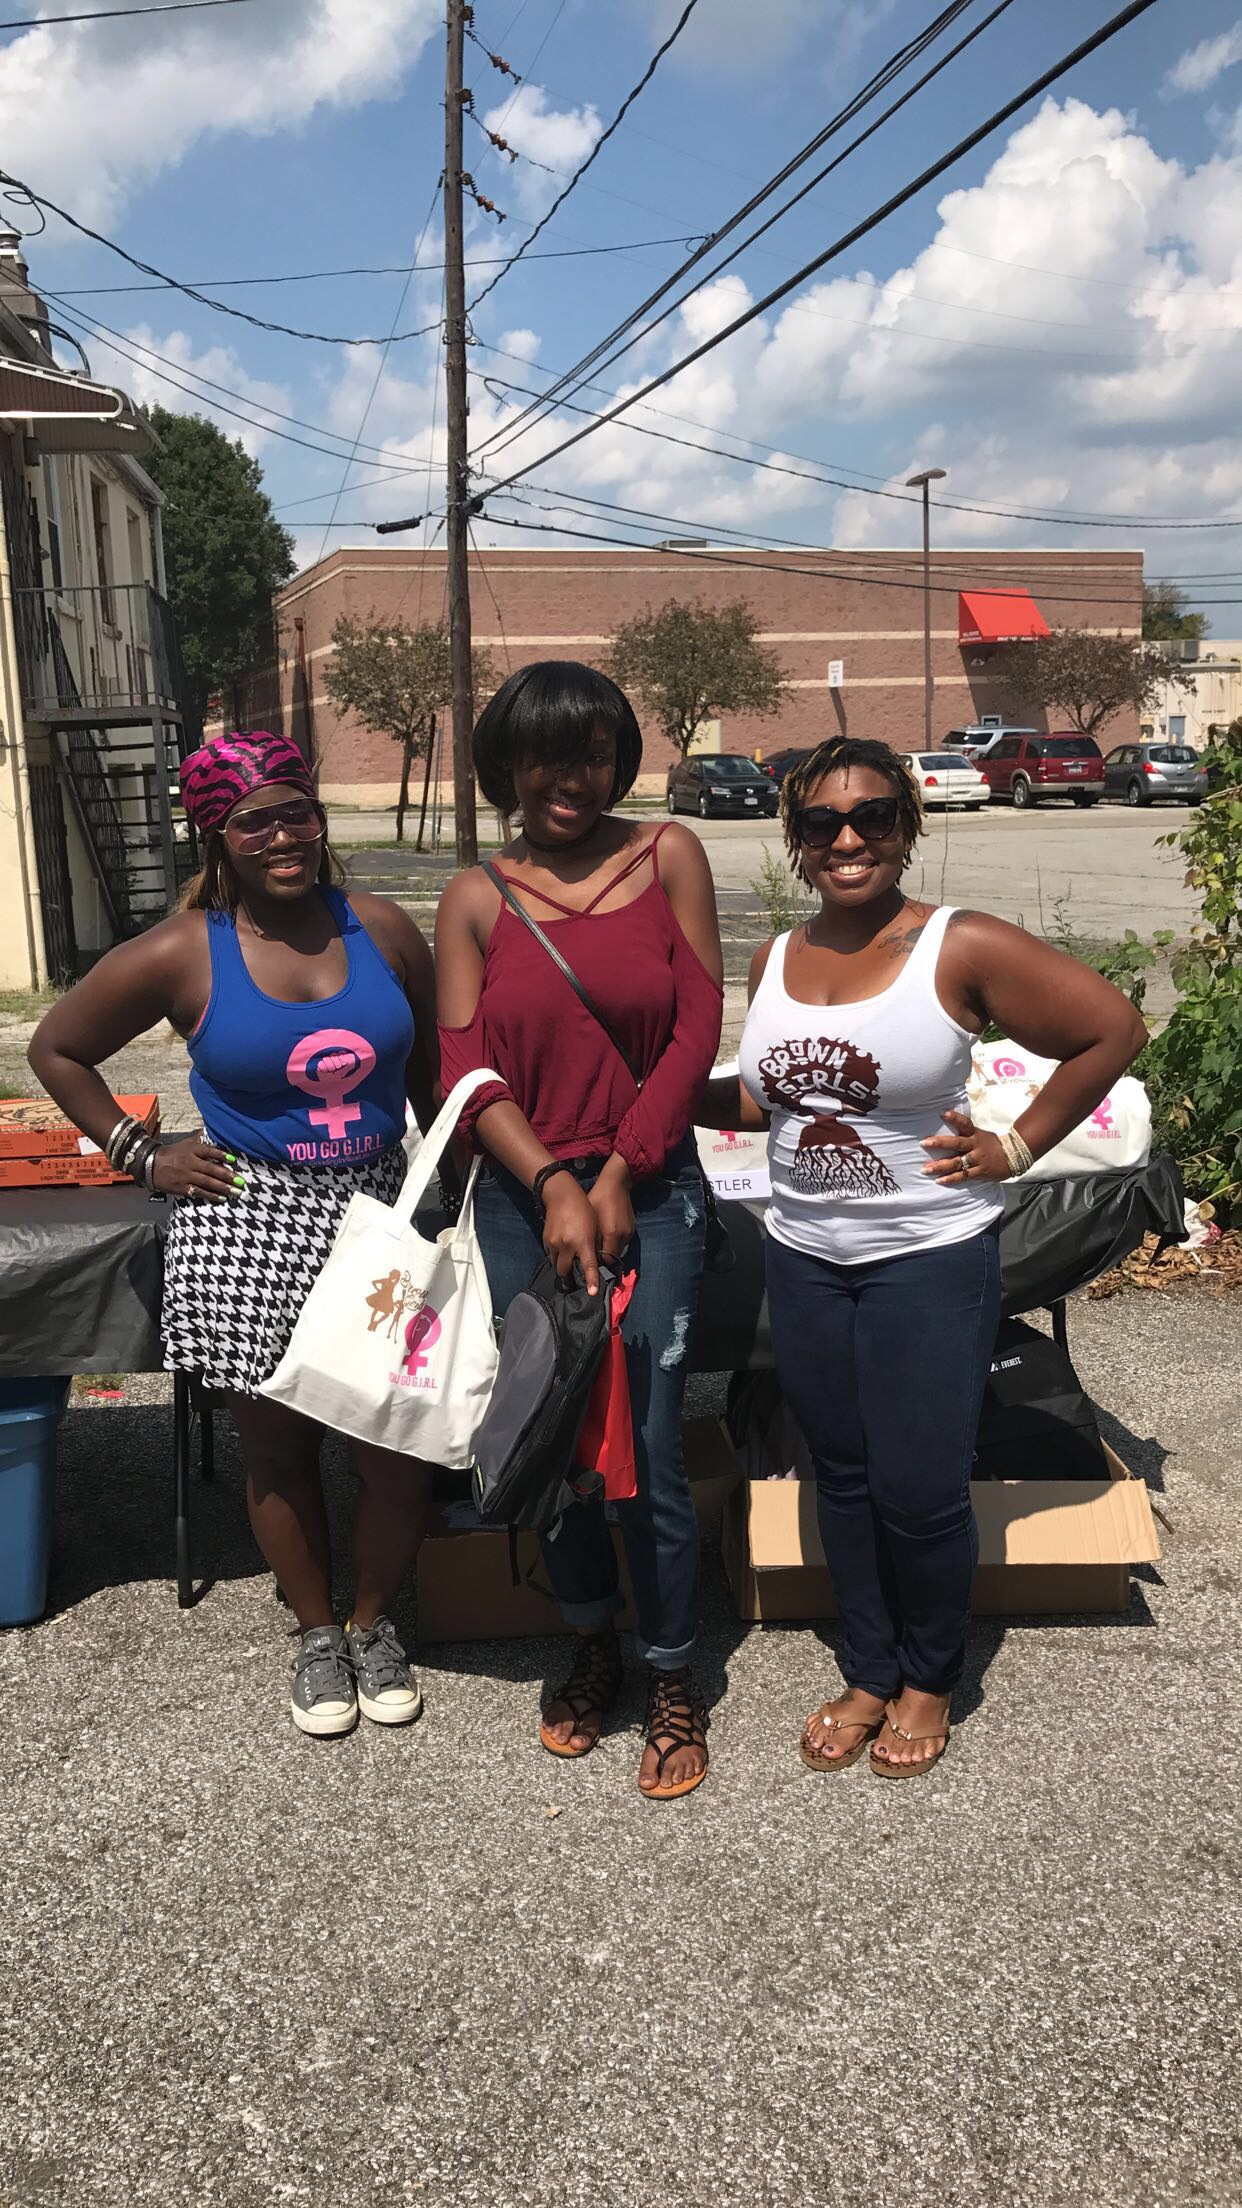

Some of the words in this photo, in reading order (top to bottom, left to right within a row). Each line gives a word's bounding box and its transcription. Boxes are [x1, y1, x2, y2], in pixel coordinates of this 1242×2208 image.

[760, 1042, 848, 1079] BROWN
[775, 1070, 871, 1100] GIRLS
[286, 1142, 317, 1161] YOU
[320, 1141, 339, 1159] GO
[712, 1144, 724, 1153] YOU
[724, 1142, 734, 1151] GO
[389, 1371, 401, 1384] OU
[400, 1375, 411, 1386] GO
